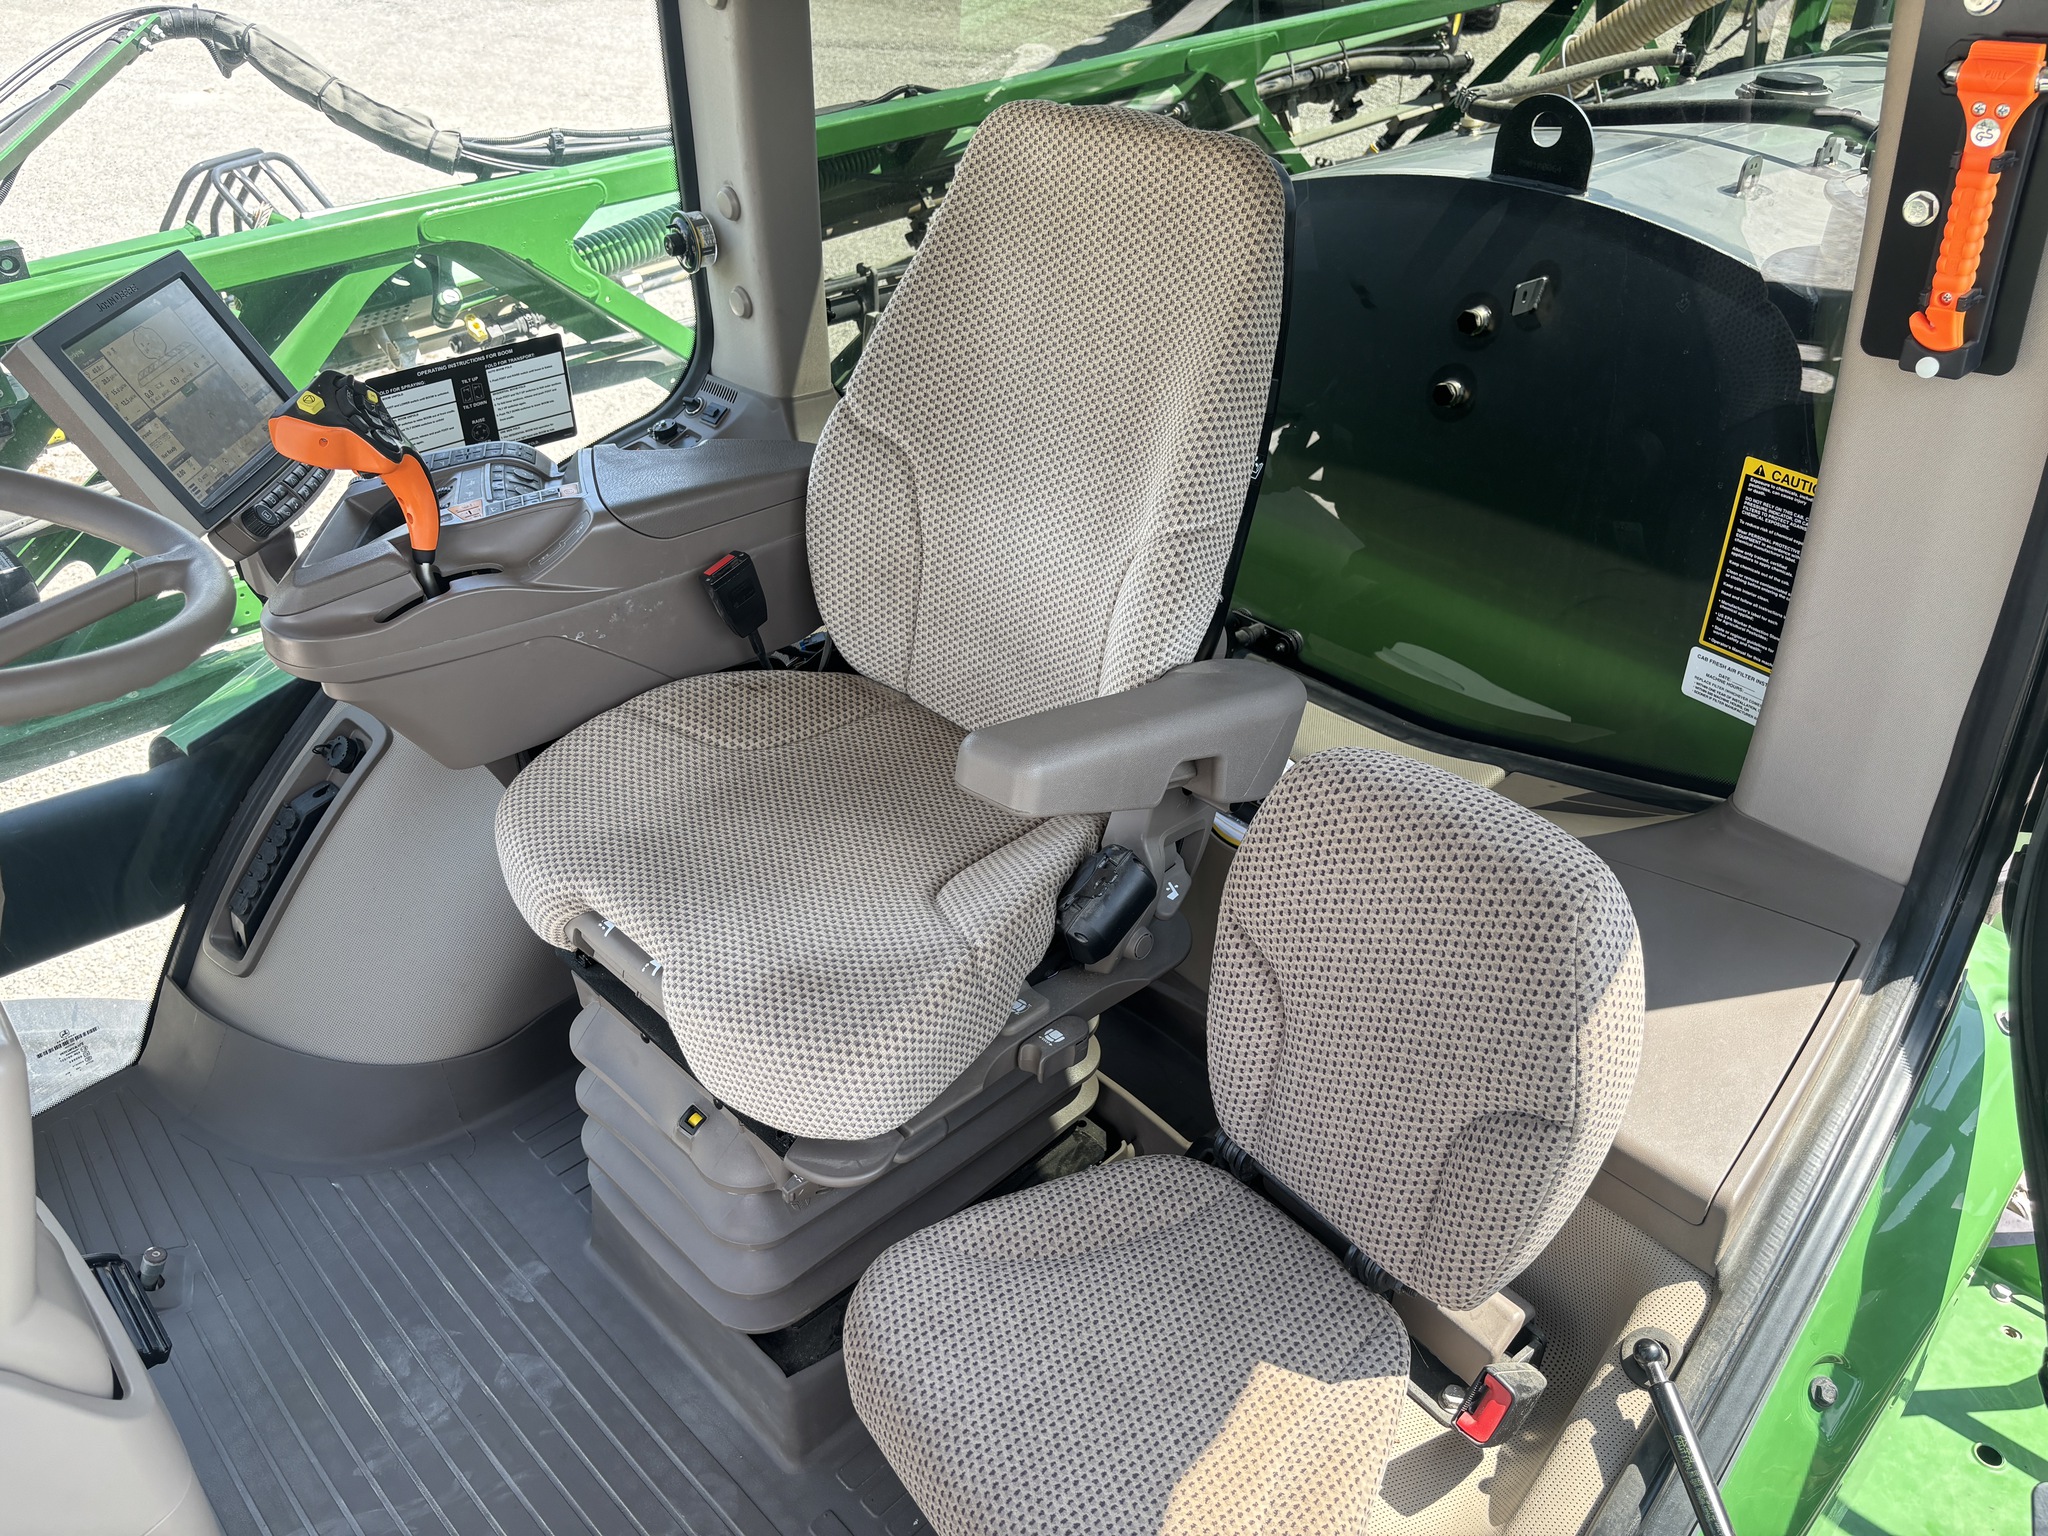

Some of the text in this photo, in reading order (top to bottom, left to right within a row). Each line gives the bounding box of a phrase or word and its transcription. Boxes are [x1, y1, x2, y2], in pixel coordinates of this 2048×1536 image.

[96, 296, 116, 312] JOHN
[417, 365, 447, 377] OPERATING
[447, 355, 485, 369] INSTRUCTIONS
[497, 348, 513, 357] BOOM
[1697, 654, 1708, 662] CAB
[1709, 659, 1727, 670] FRESH
[1727, 666, 1737, 674] AIR
[1737, 670, 1755, 682] FILTER
